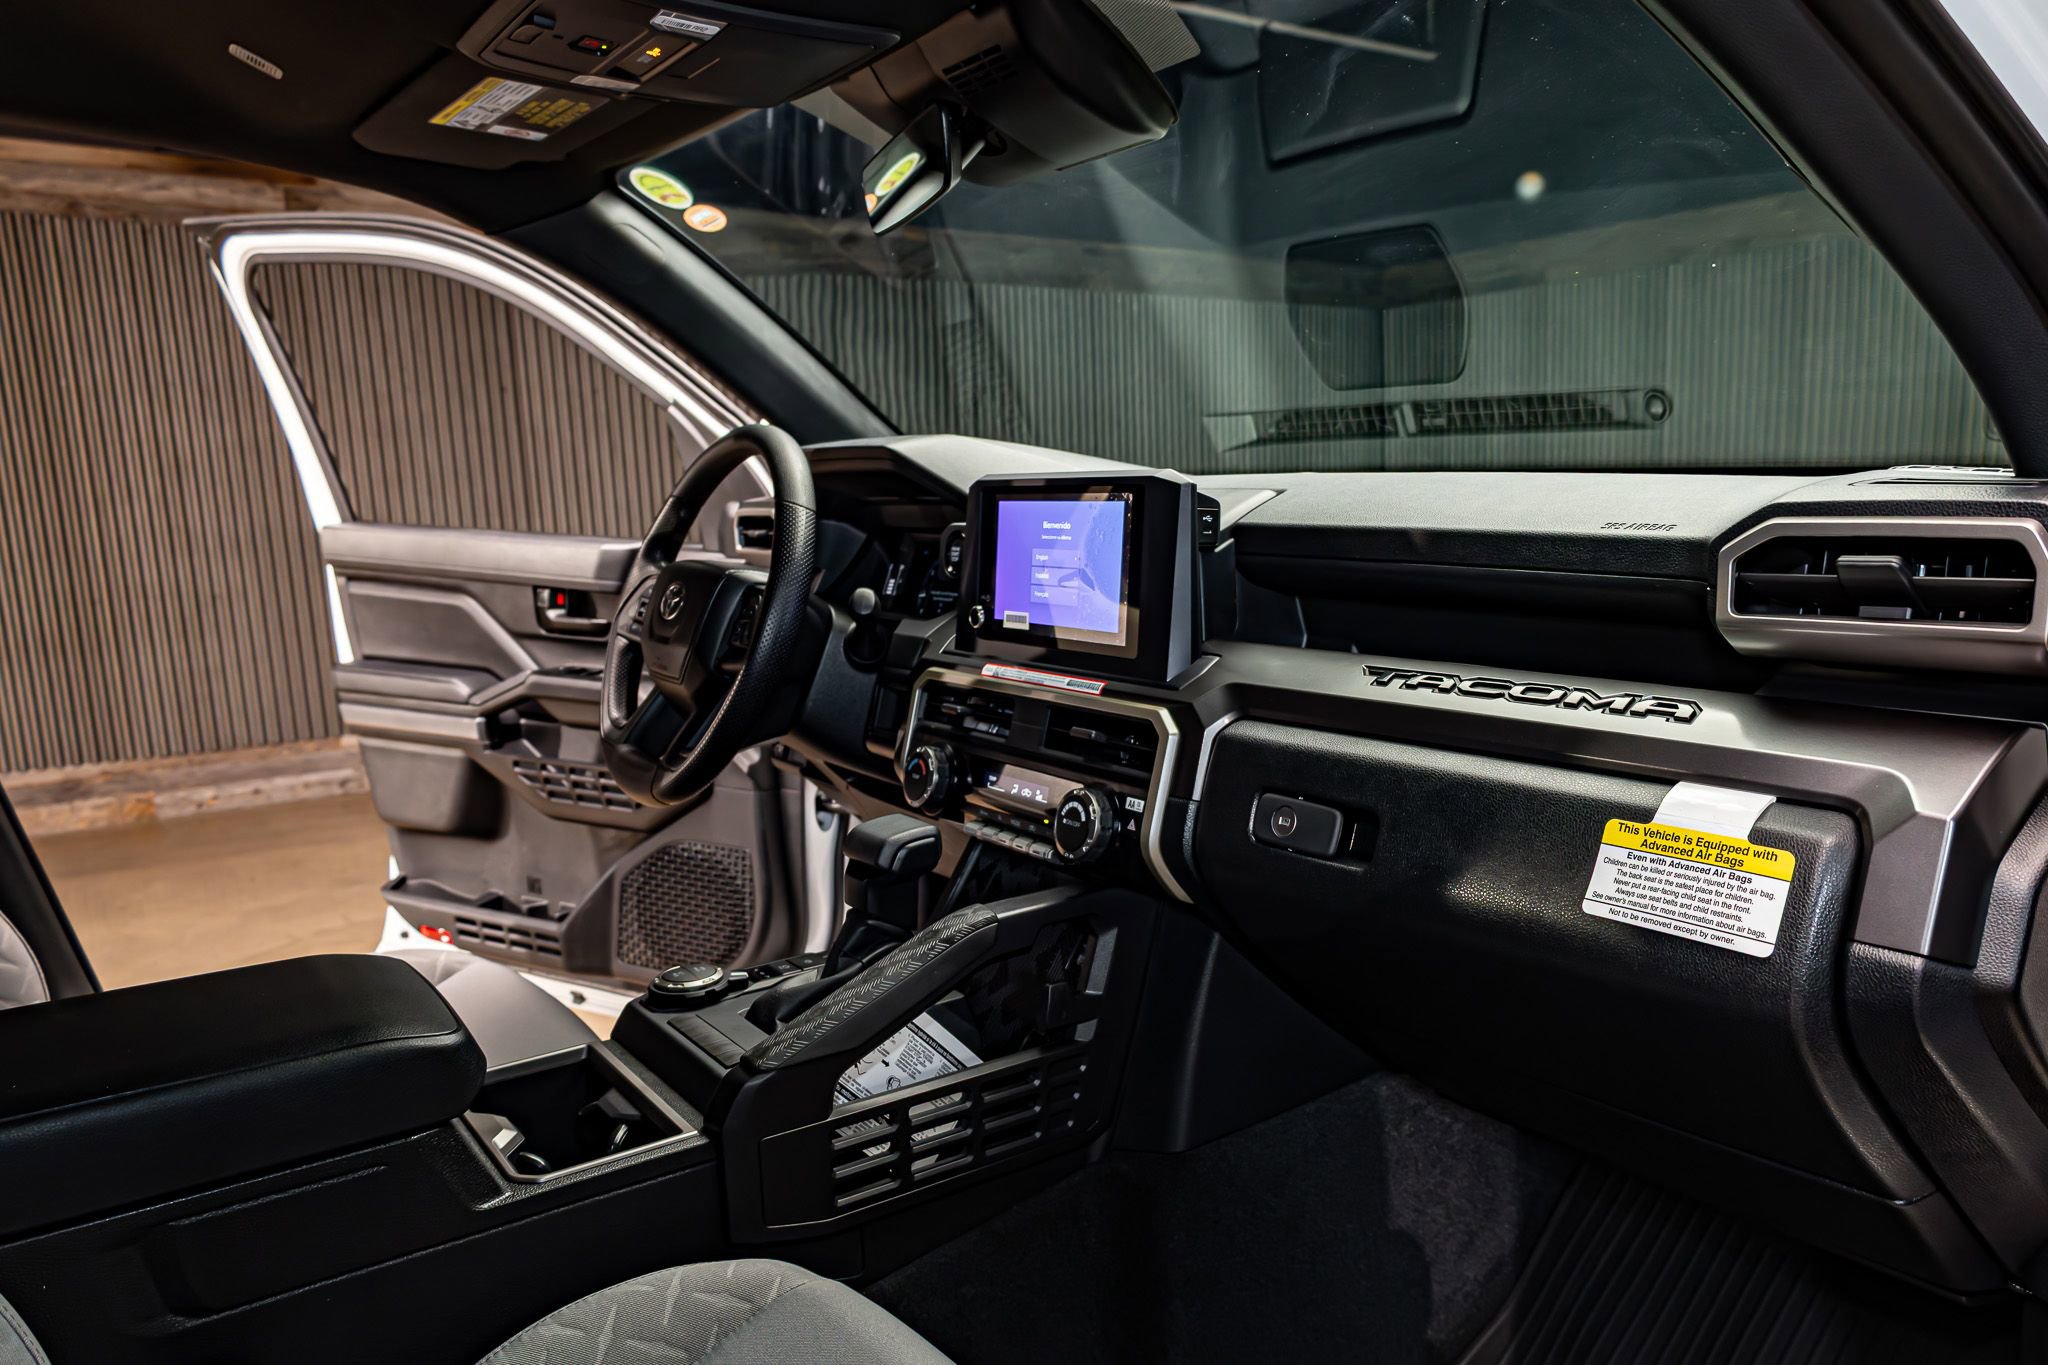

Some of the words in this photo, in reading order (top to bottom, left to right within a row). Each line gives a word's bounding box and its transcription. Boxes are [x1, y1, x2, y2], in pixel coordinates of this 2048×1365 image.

[1362, 664, 1704, 724] TACOMA
[1618, 821, 1640, 836] This
[1643, 826, 1681, 843] Vehicle
[1682, 834, 1694, 846] is
[1695, 836, 1751, 857] Equipped
[1753, 849, 1778, 862] with
[1639, 838, 1695, 858] Advanced
[1694, 849, 1713, 861] Air
[1714, 852, 1745, 869] Bags
[1603, 856, 1628, 868] Children
[1640, 864, 1649, 873] be
[1649, 866, 1666, 876] killed
[1673, 872, 1702, 885] seriously
[1702, 878, 1726, 889] injured
[1726, 882, 1736, 892] by
[1736, 884, 1748, 894] the
[1759, 889, 1775, 901] bag.
[1617, 868, 1628, 877] The
[1628, 871, 1643, 880] back
[1643, 875, 1658, 883] seat
[1663, 879, 1675, 887] the
[1674, 882, 1695, 891] safest
[1694, 886, 1714, 896] place
[1714, 889, 1724, 898] for
[1724, 892, 1754, 904] children.
[1626, 851, 1648, 863] Even
[1649, 857, 1667, 867] with
[1667, 859, 1712, 875] Advanced
[1712, 868, 1727, 879] Air
[1728, 871, 1753, 885] Bags
[1613, 877, 1632, 887] Never
[1630, 882, 1642, 890] put
[1647, 885, 1680, 899] rear-facing
[1680, 892, 1697, 902] child
[1697, 896, 1713, 905] seat
[1720, 901, 1733, 910] the
[1733, 903, 1751, 914] front.
[1614, 886, 1636, 898] Always
[1648, 895, 1662, 903] seat
[1662, 897, 1678, 907] belts
[1678, 902, 1693, 911] and
[1692, 905, 1710, 915] child
[1709, 909, 1743, 922] restraints.
[1591, 890, 1604, 900] See
[1604, 894, 1627, 905] owner's
[1626, 900, 1650, 910] manual
[1649, 903, 1659, 912] for
[1659, 907, 1677, 917] more
[1677, 911, 1715, 926] information
[1715, 920, 1736, 931] about
[1746, 927, 1766, 939] bags.
[1608, 907, 1621, 917] Not
[1621, 911, 1629, 919] to
[1629, 912, 1640, 921] be
[1640, 916, 1672, 929] removed
[1673, 924, 1698, 936] except
[1699, 929, 1709, 940] by
[1710, 933, 1734, 945] owner.
